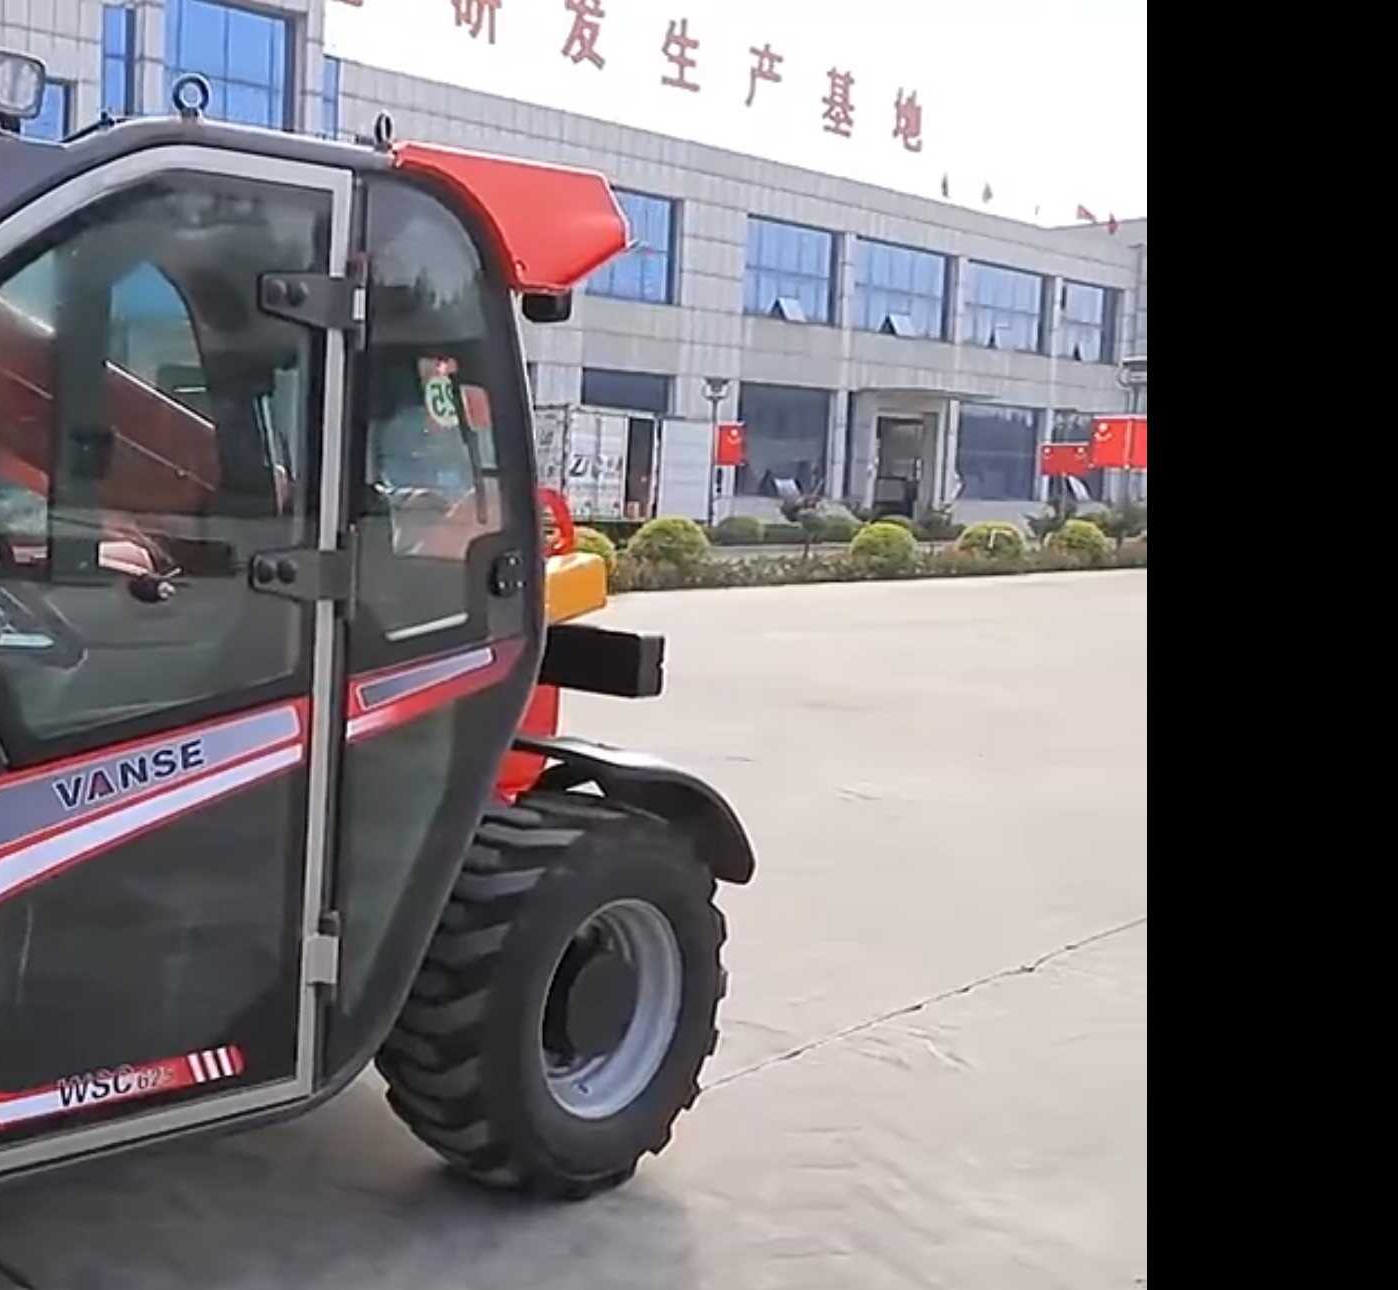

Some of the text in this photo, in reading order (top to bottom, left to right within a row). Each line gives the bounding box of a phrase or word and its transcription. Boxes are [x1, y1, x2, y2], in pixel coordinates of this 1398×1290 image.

[330, 0, 923, 153] 研发生产基地
[55, 739, 204, 809] VANSE
